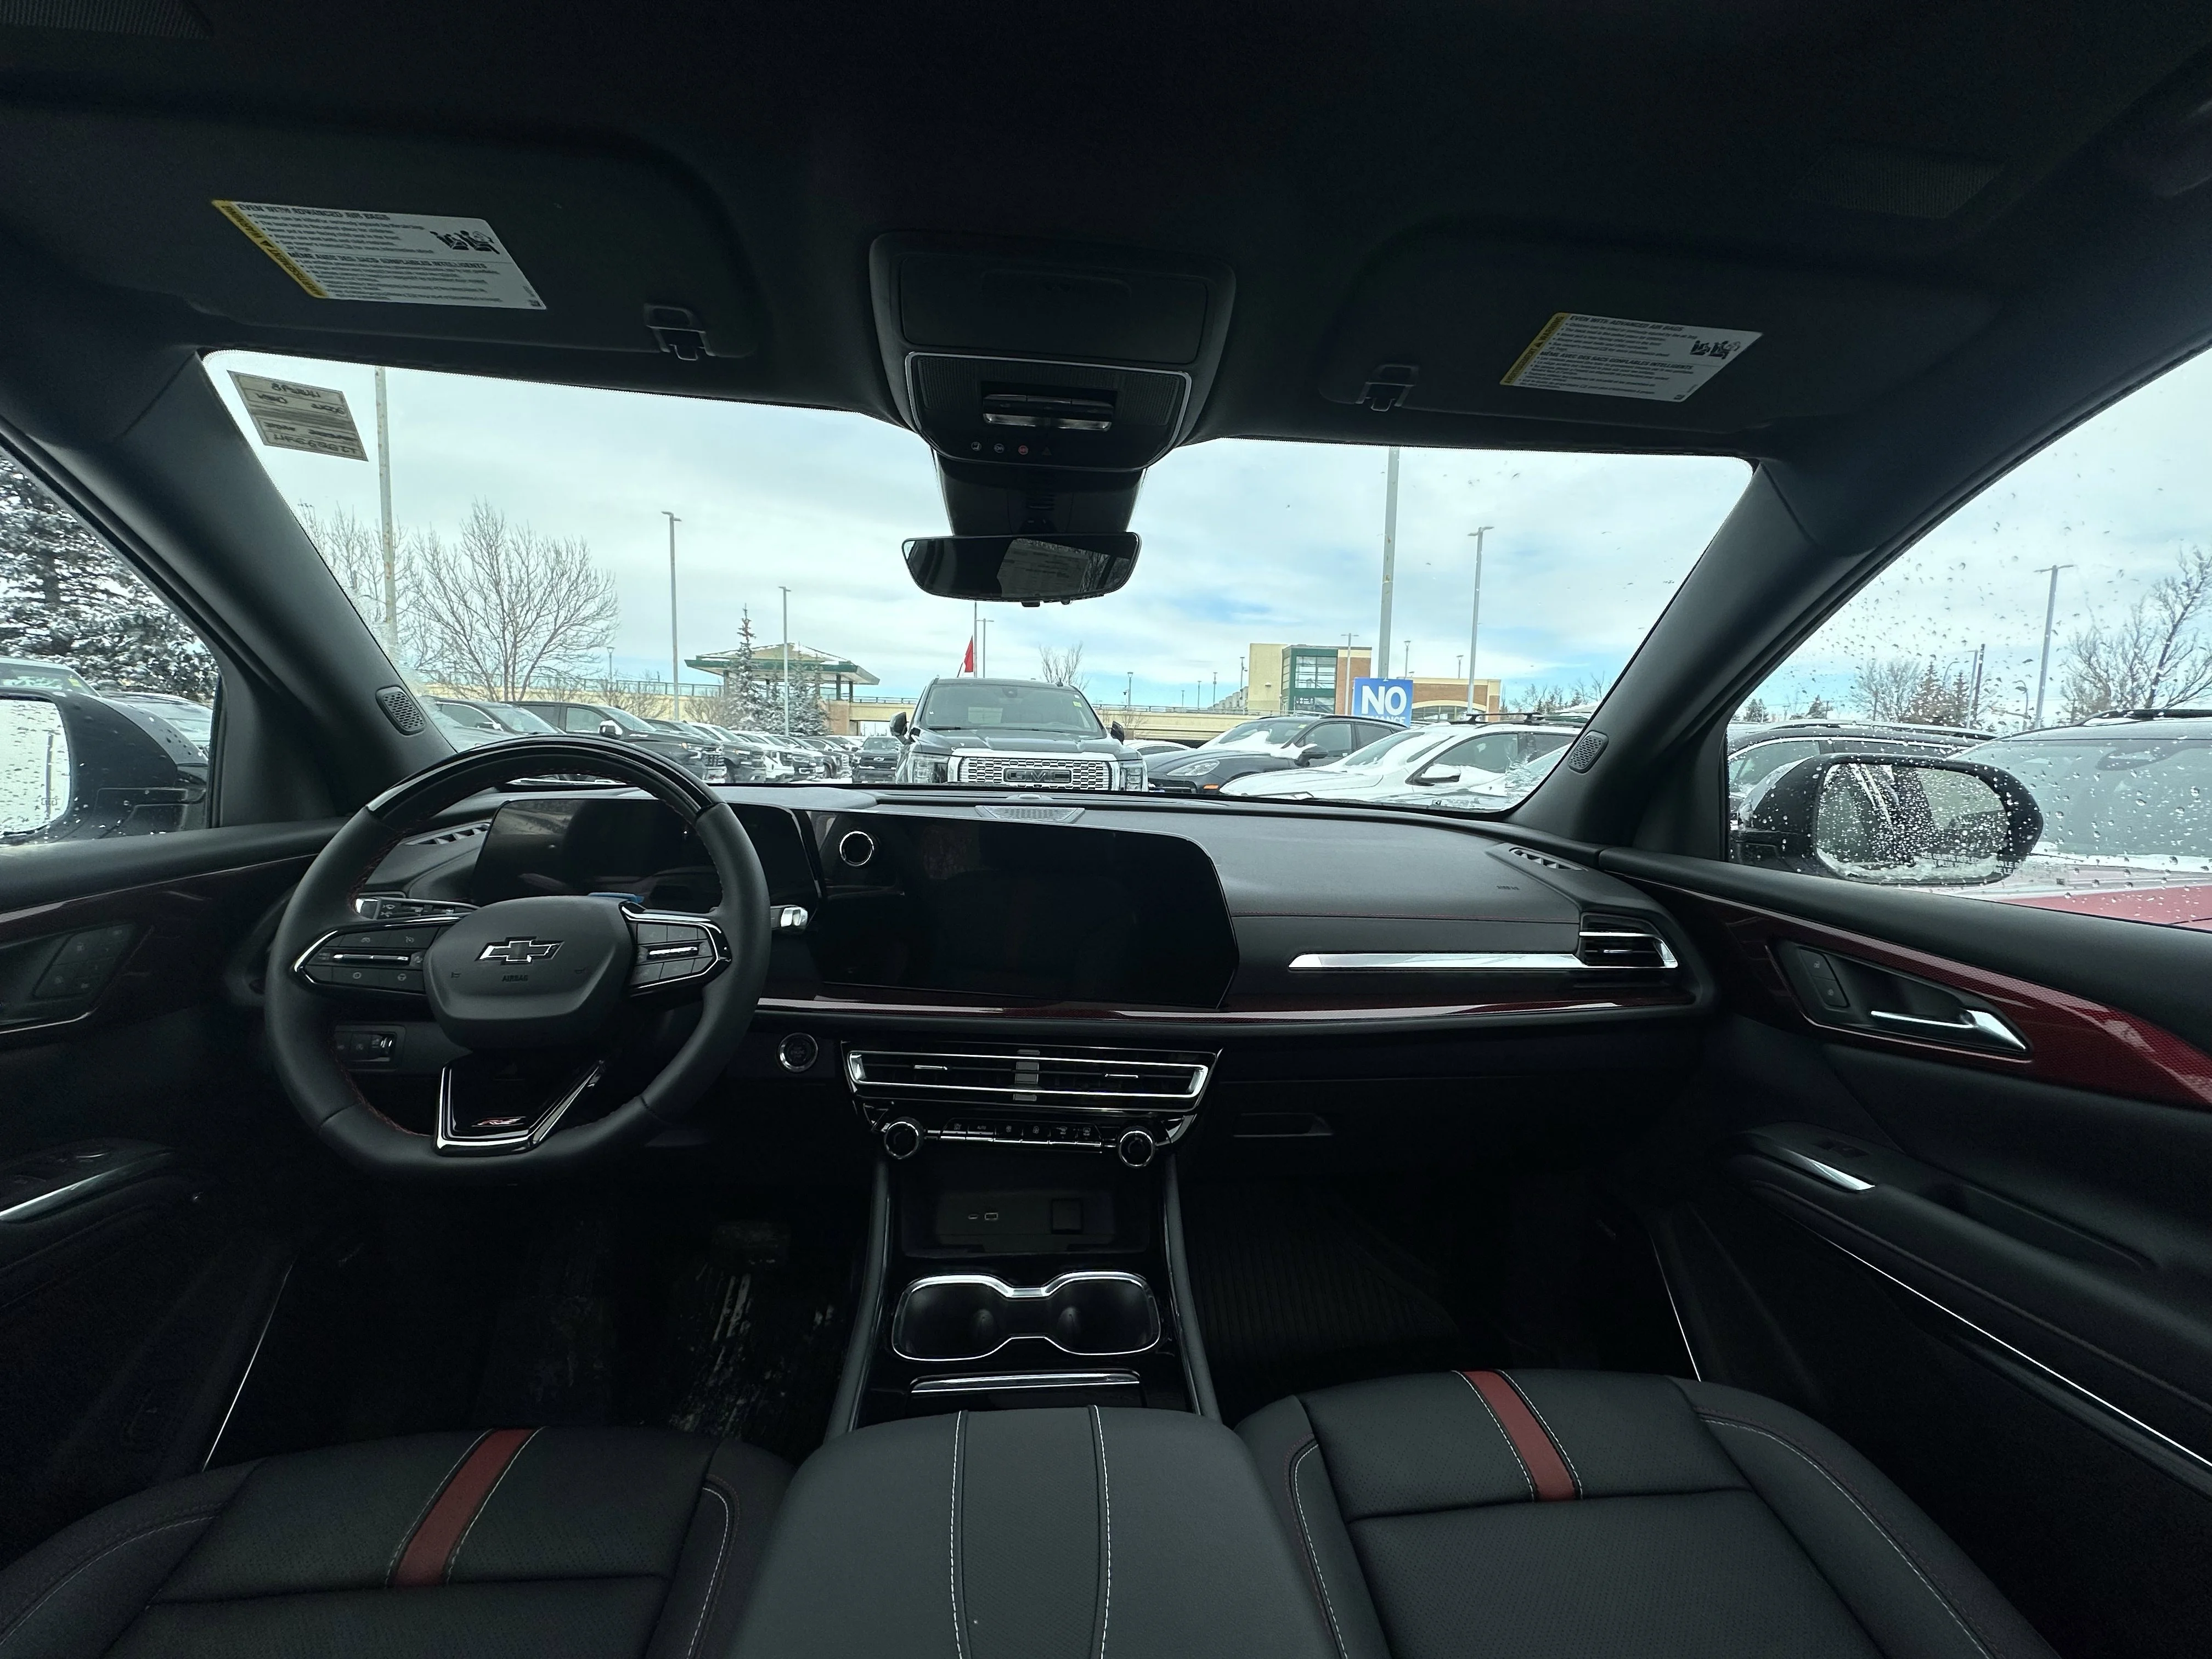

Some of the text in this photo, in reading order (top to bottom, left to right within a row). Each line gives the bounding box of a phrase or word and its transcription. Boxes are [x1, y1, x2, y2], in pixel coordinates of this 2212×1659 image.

[1362, 686, 1407, 715] NO
[1006, 769, 1070, 783] GMC
[1933, 853, 1956, 861] OBJETS
